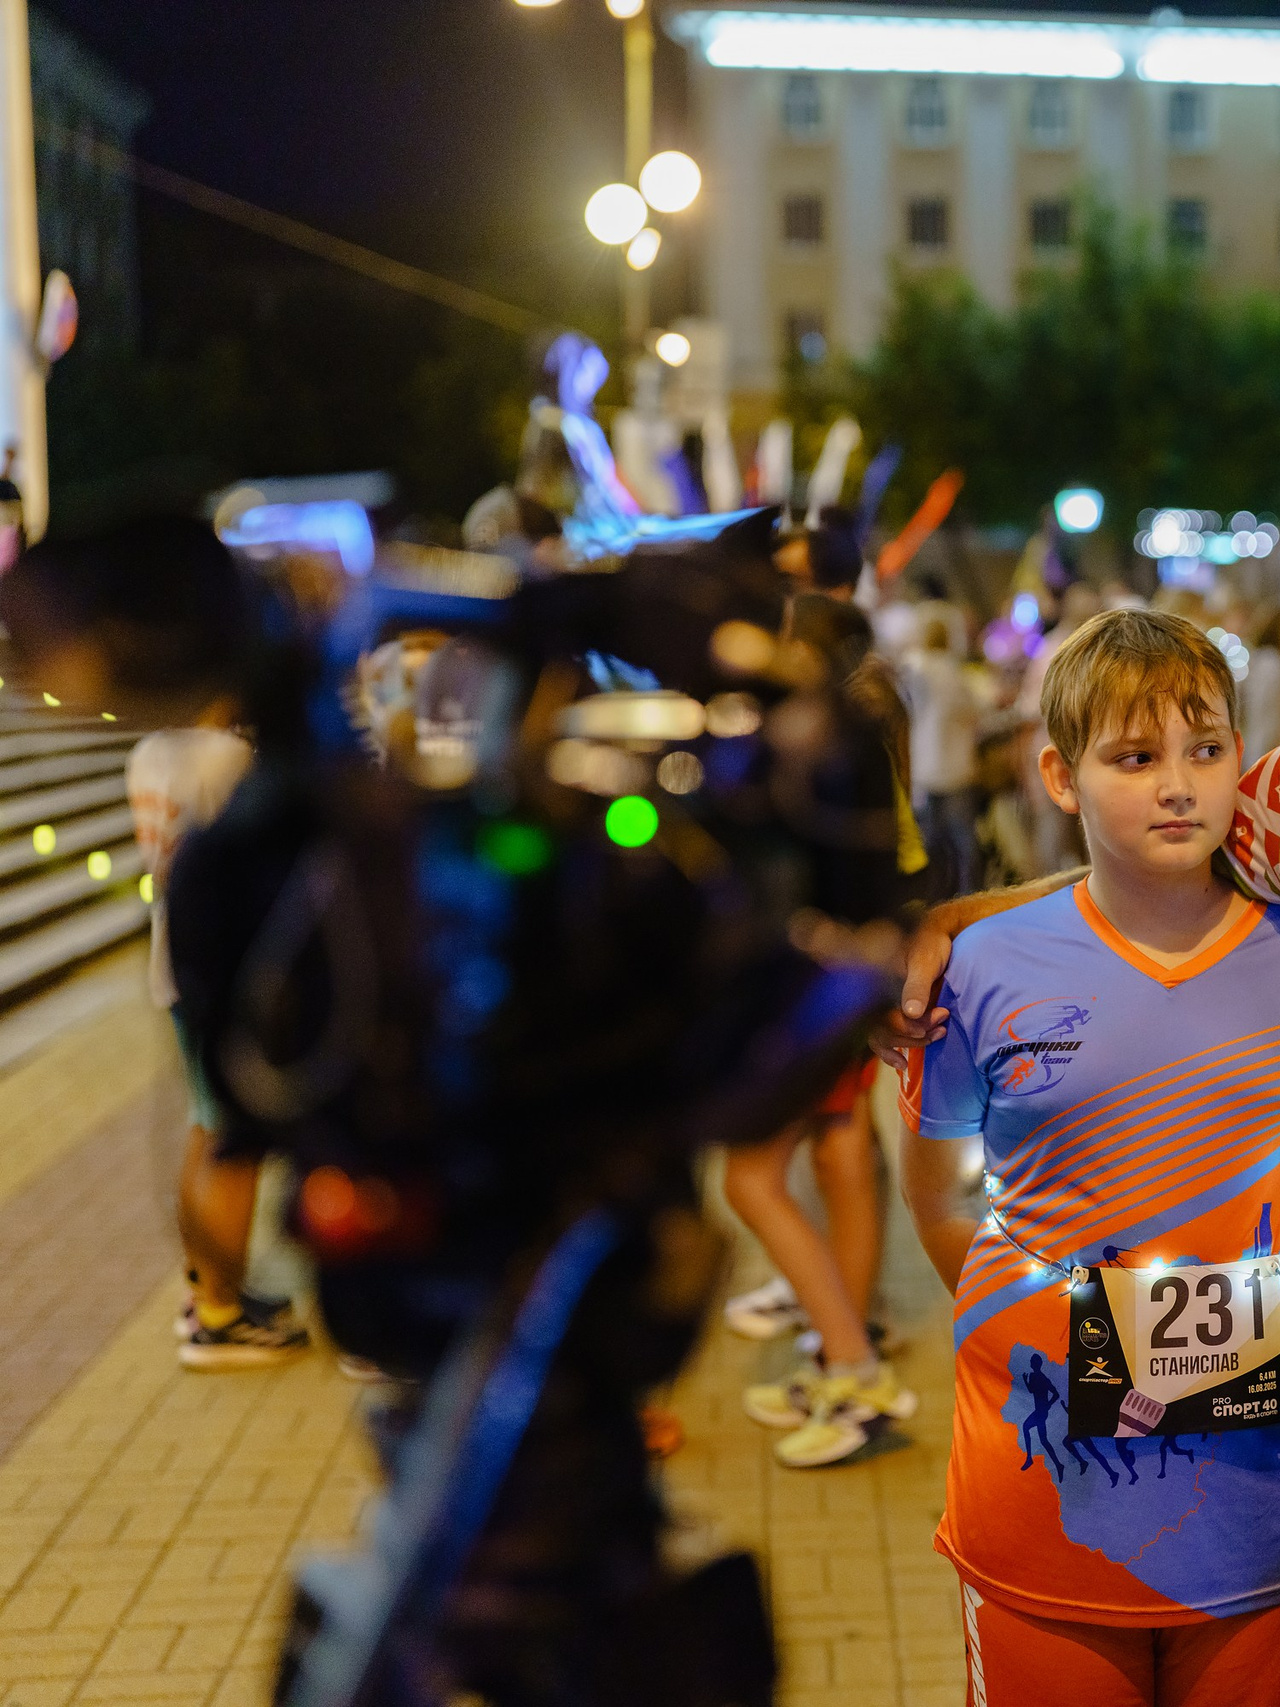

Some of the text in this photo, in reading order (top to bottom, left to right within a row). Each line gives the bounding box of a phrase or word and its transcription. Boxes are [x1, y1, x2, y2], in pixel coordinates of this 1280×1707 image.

[1041, 1052, 1072, 1064] team
[1151, 1268, 1264, 1348] 231
[1149, 1352, 1239, 1376] СТАНИСЛАВ
[1212, 1397, 1231, 1405] PRO
[1213, 1398, 1277, 1417] СПОРТ 40
